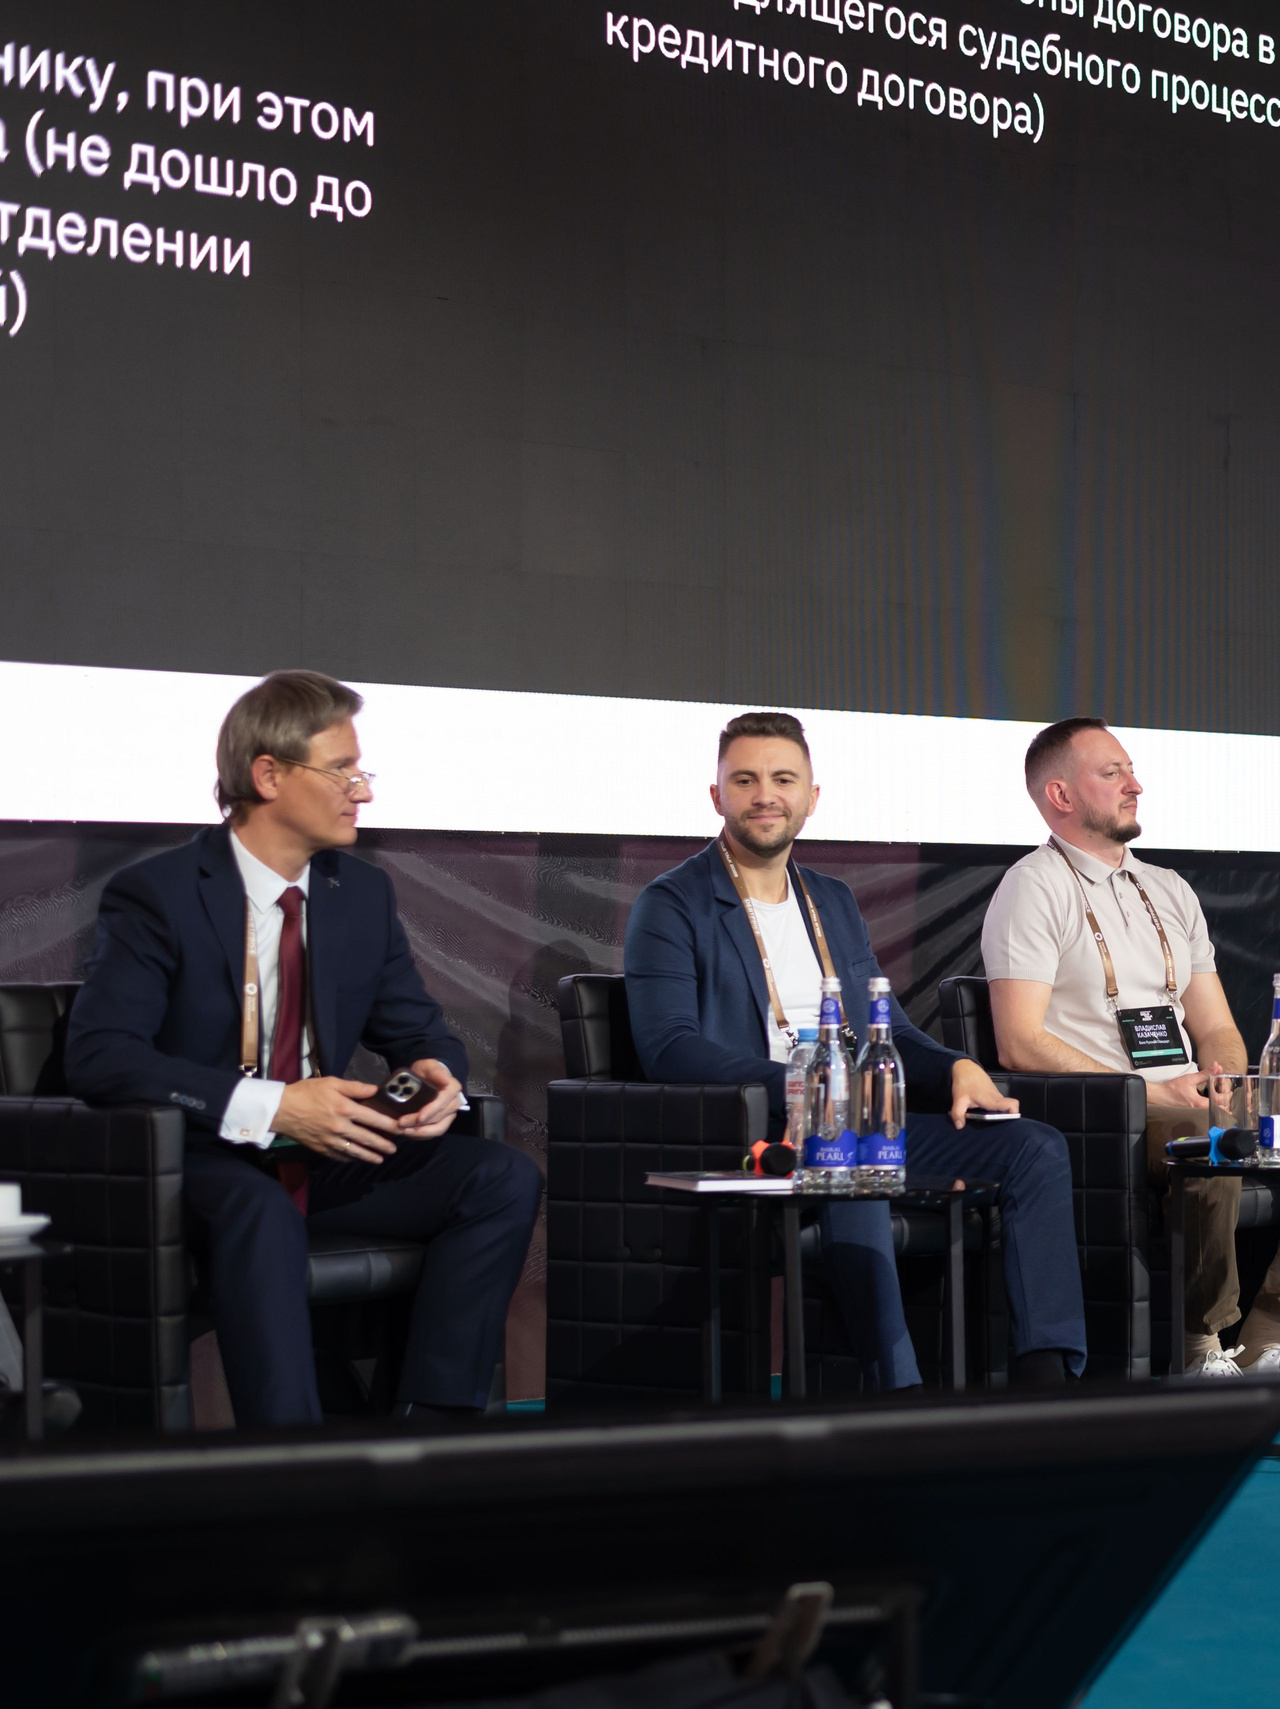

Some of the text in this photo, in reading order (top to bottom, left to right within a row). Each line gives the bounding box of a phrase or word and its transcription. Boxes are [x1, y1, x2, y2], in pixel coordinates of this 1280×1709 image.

[958, 24, 1140, 93] судебного
[1094, 0, 1249, 61] договора
[1258, 34, 1276, 64] в
[147, 71, 241, 128] при
[257, 91, 375, 147] этом
[606, 12, 1045, 143] кредитного договора)
[25, 109, 112, 177] (не
[124, 143, 298, 206] дошло
[310, 175, 372, 222] до
[744, 898, 761, 934] DEBTPRICE
[1145, 900, 1161, 930] DEBTPRICE
[1134, 1024, 1167, 1032] ВЛАДИСЛАВ
[815, 1151, 845, 1161] PEARL
